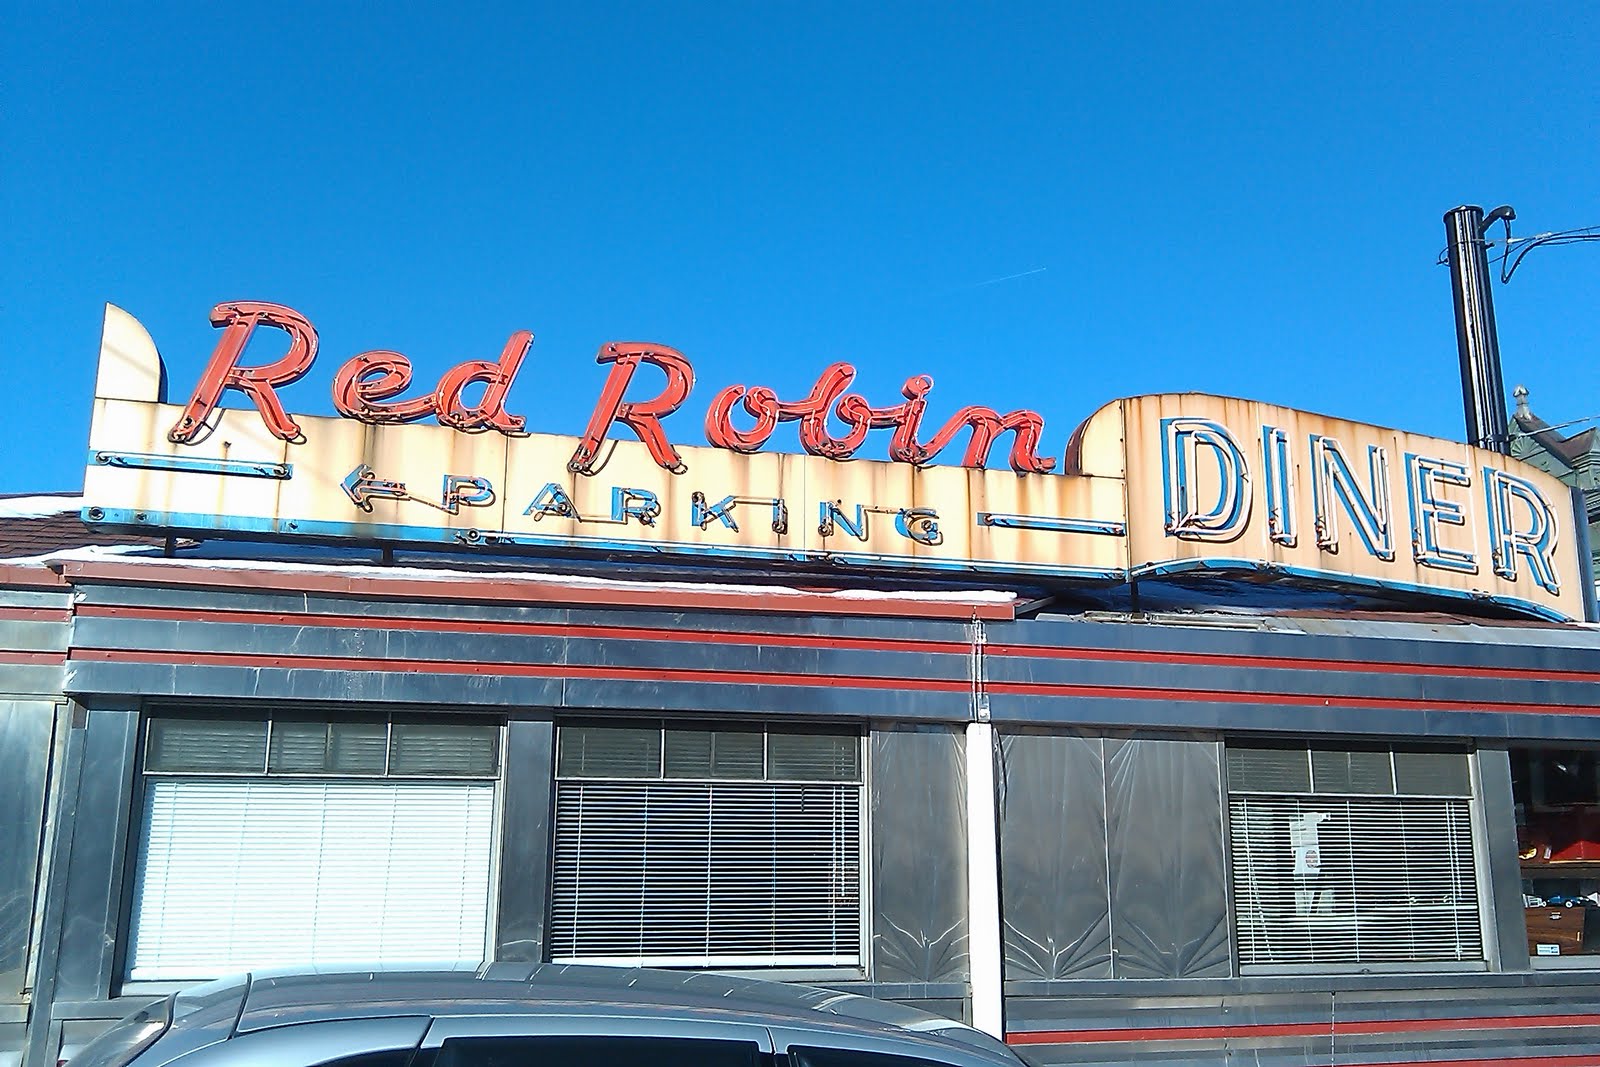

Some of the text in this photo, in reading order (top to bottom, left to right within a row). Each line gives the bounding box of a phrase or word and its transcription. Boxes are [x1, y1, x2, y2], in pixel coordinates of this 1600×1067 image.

[167, 300, 1056, 475] Red Robin
[443, 474, 943, 545] PARKING
[1160, 416, 1561, 595] DINER
